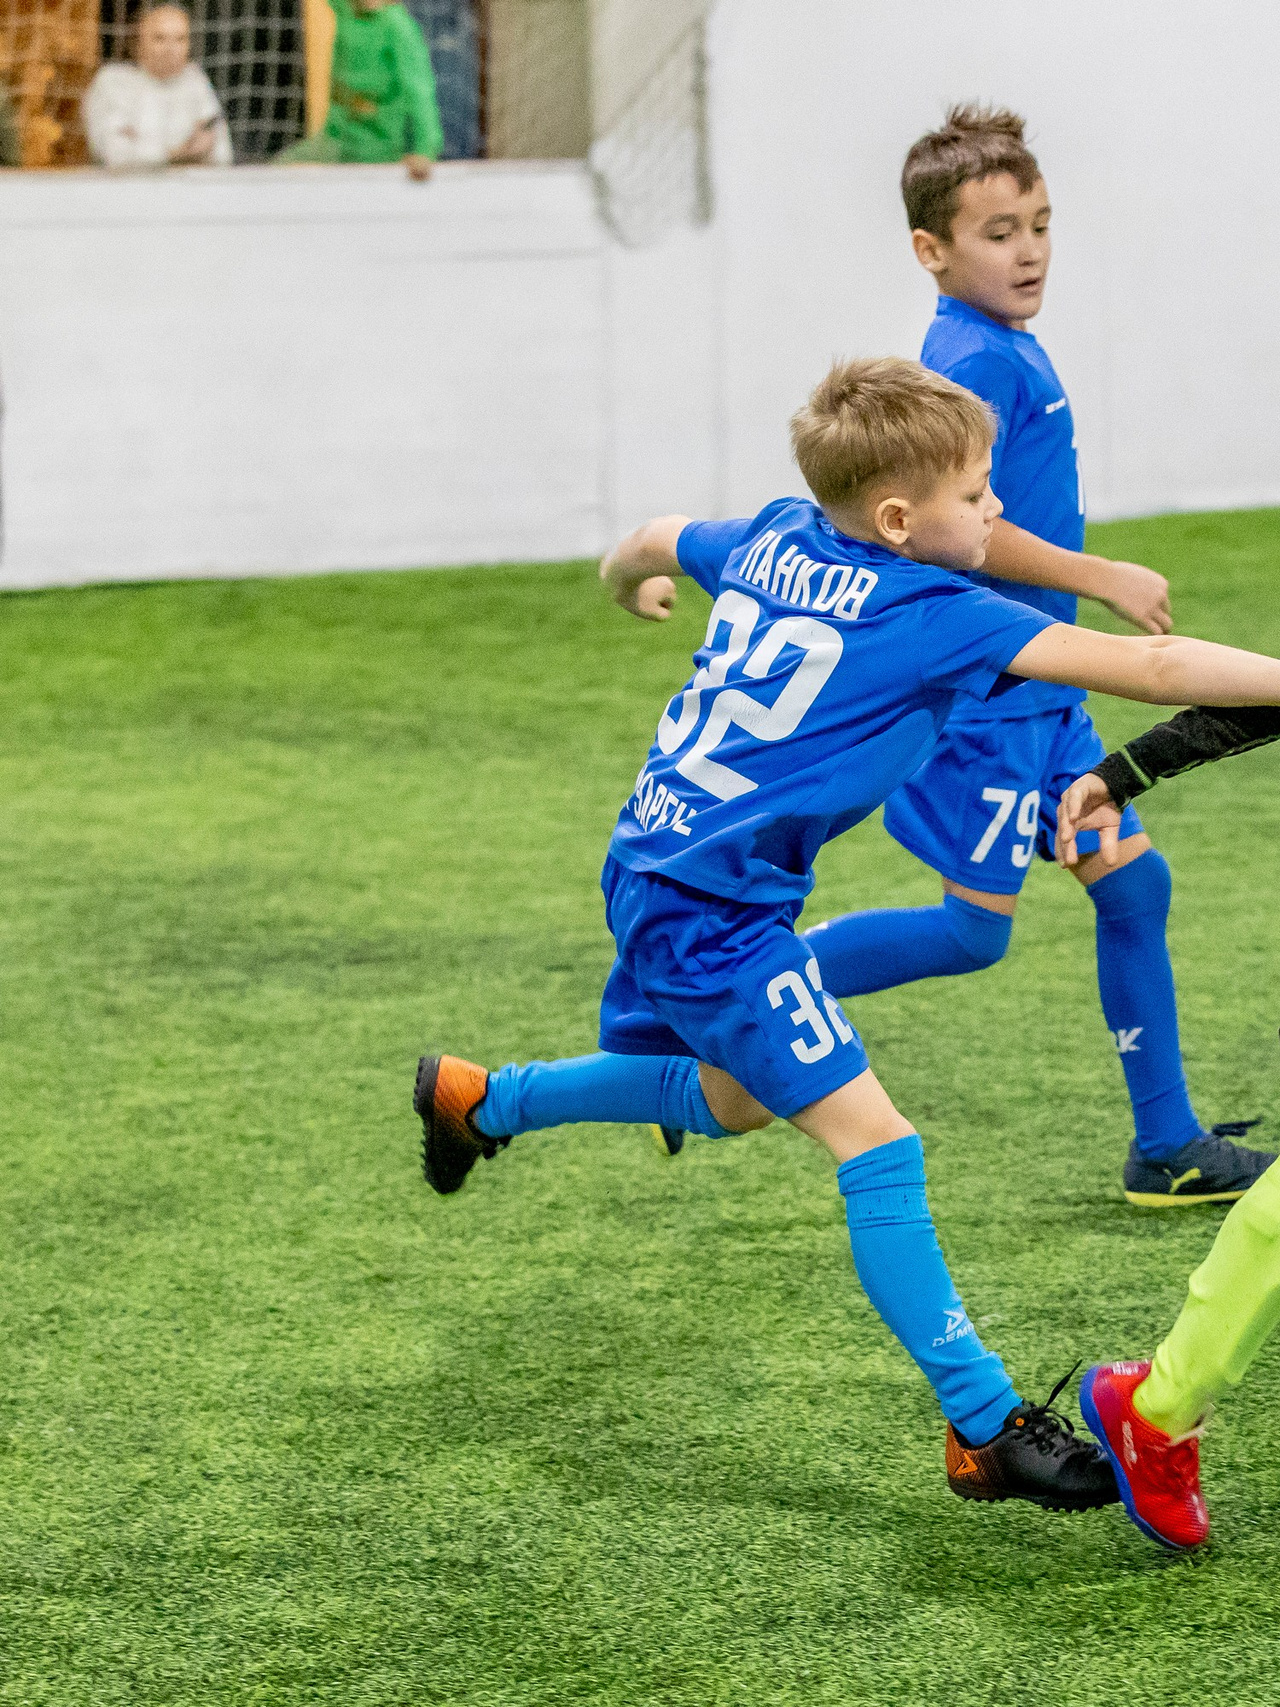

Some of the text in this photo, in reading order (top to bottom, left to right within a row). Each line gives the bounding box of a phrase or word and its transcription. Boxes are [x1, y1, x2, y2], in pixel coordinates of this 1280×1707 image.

[738, 529, 879, 621] ПАНКОВ
[657, 589, 844, 802] 32
[969, 786, 1041, 868] 79
